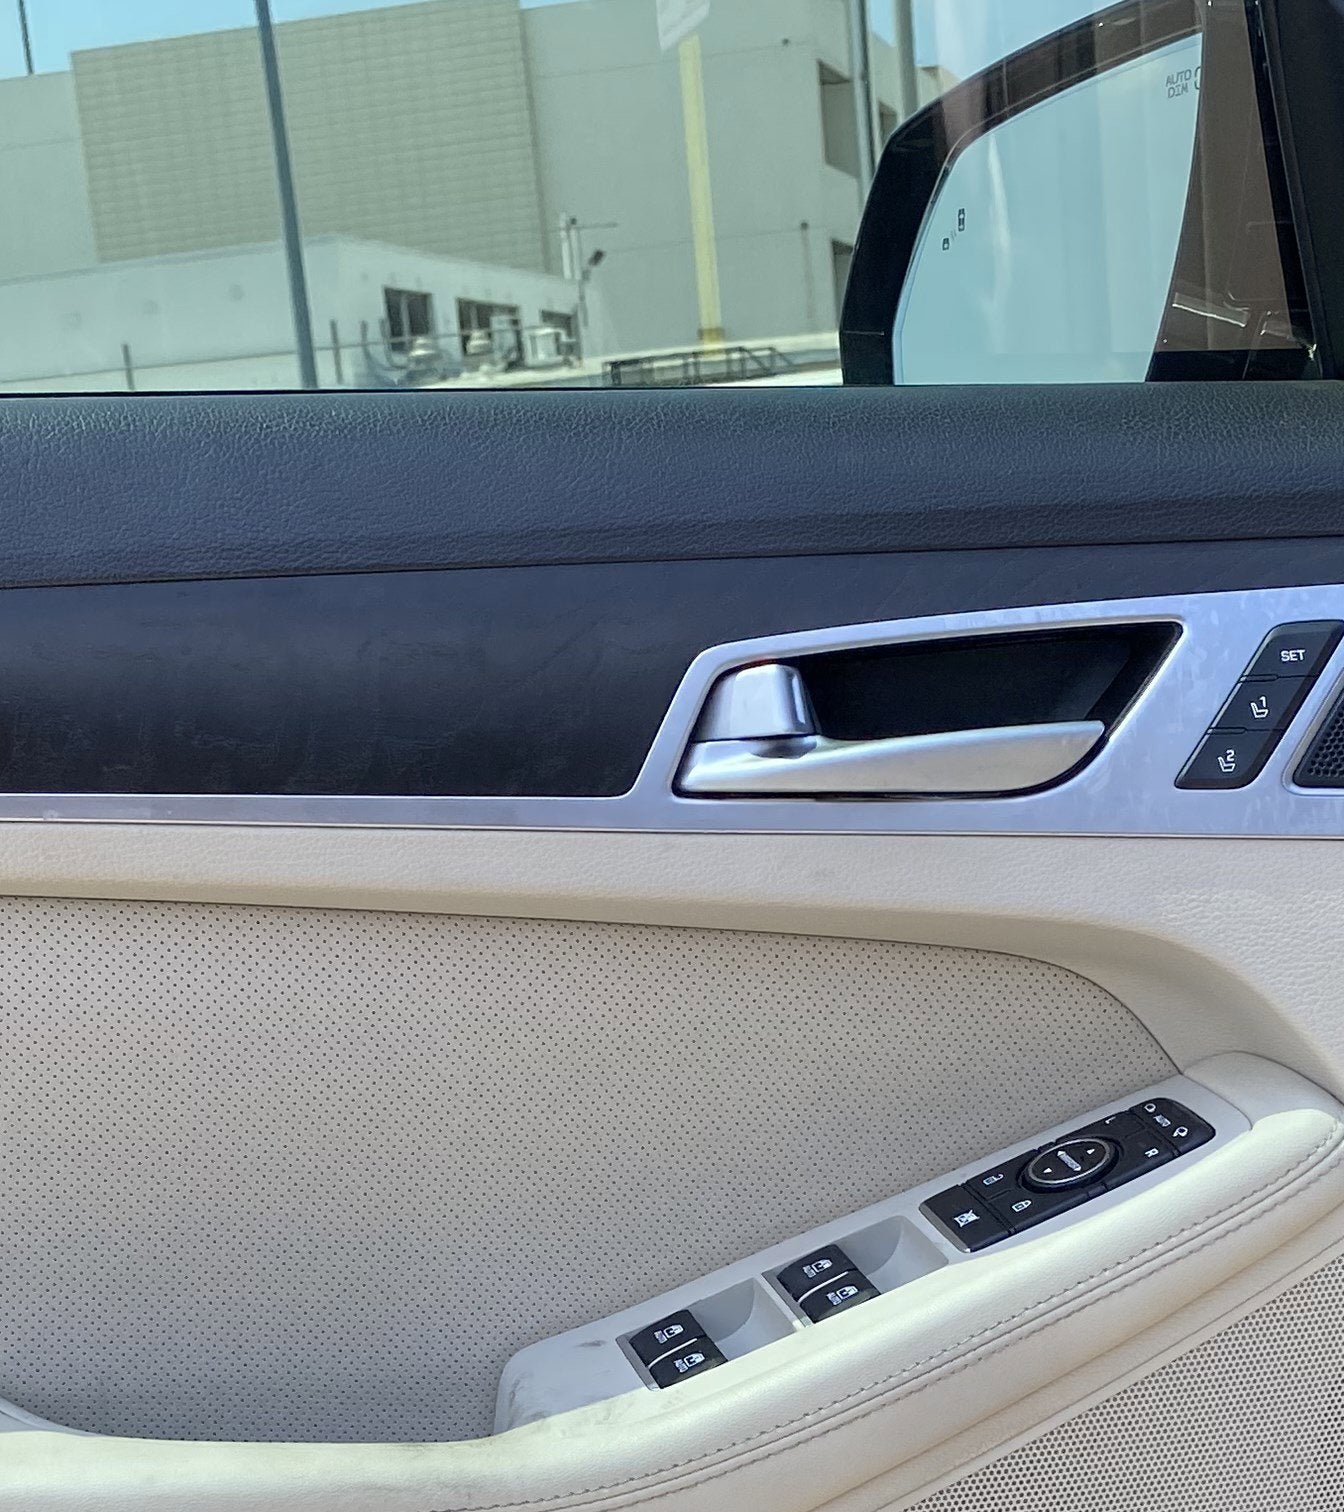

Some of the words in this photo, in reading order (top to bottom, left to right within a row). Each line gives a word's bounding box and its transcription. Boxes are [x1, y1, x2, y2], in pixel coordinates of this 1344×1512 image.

[1166, 69, 1192, 87] AUTO
[1168, 82, 1189, 98] DIM
[1280, 649, 1306, 661] SET
[1226, 749, 1235, 762] 2
[1144, 1147, 1159, 1158] R
